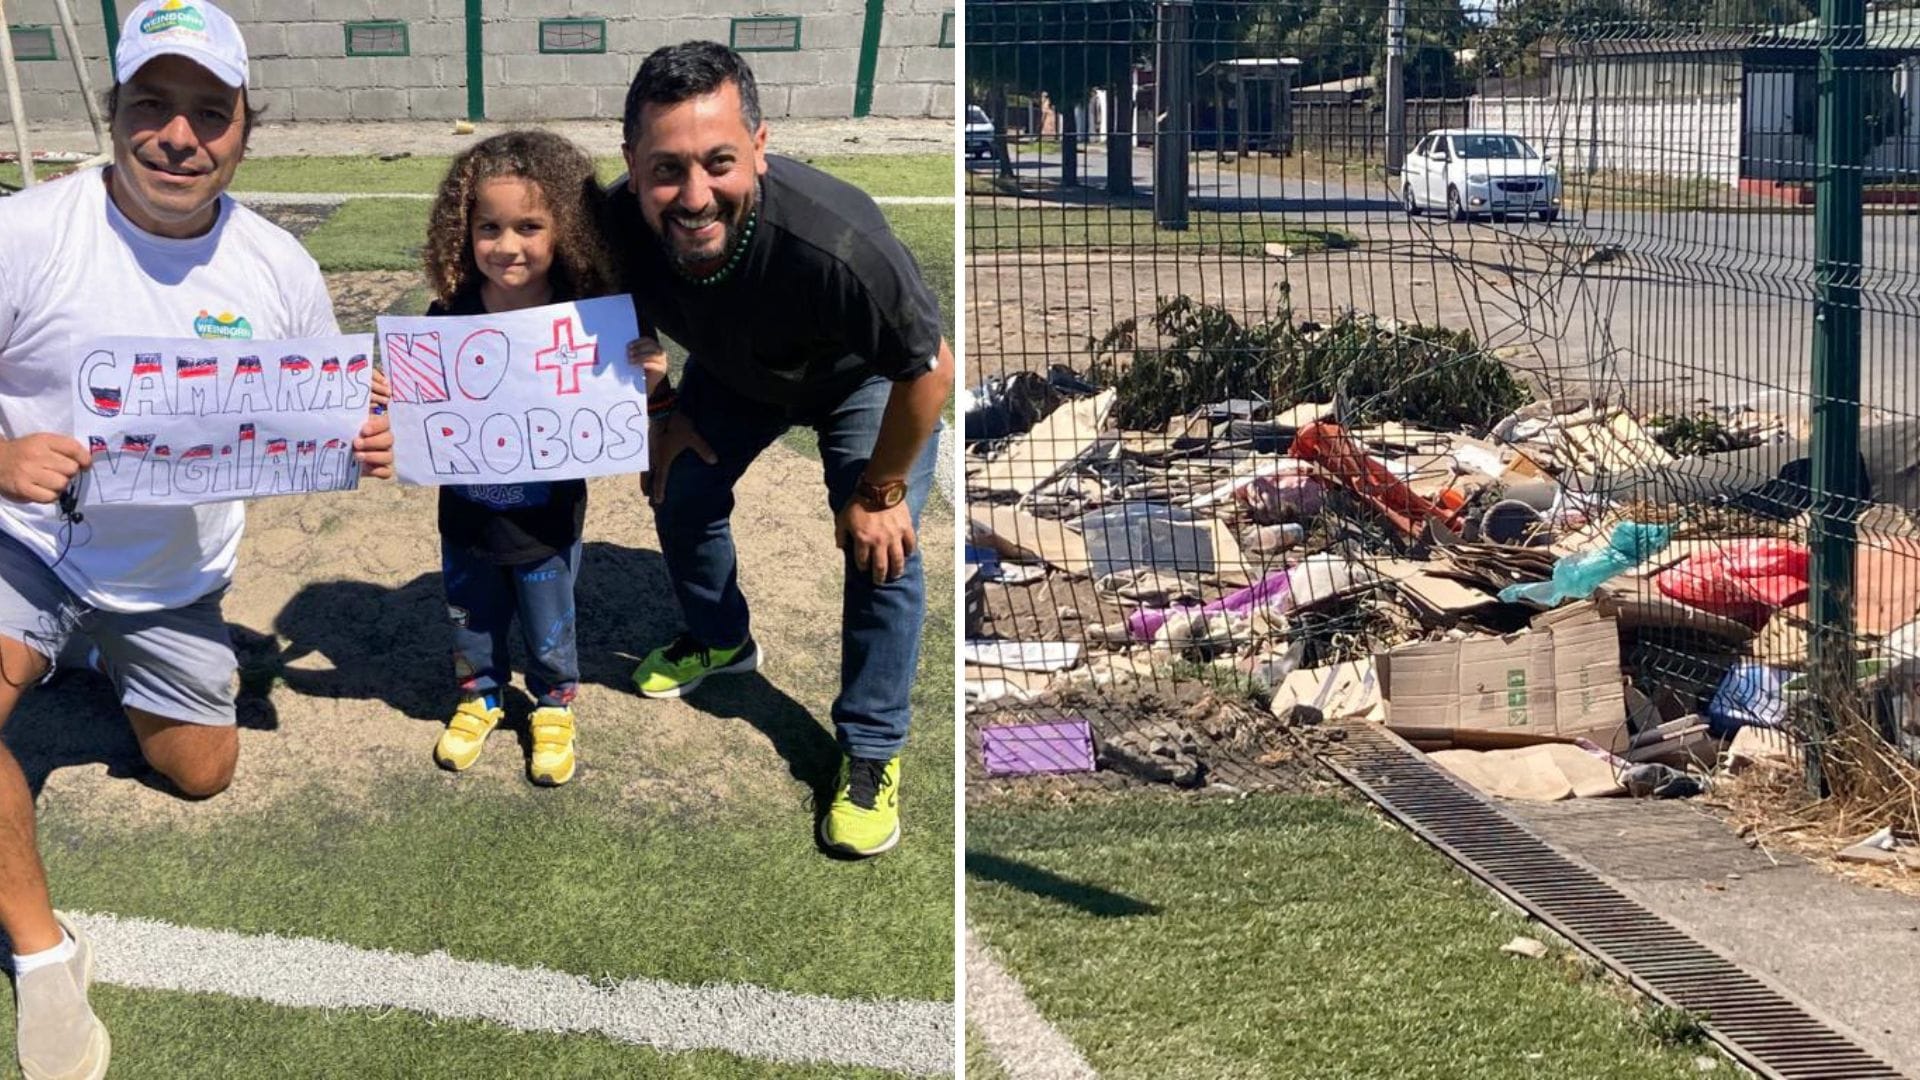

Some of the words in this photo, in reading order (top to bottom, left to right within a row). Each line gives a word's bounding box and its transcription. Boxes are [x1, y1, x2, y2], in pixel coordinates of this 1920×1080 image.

[77, 349, 370, 417] CAMARAS
[386, 329, 510, 404] NO
[424, 400, 644, 474] ROBOS
